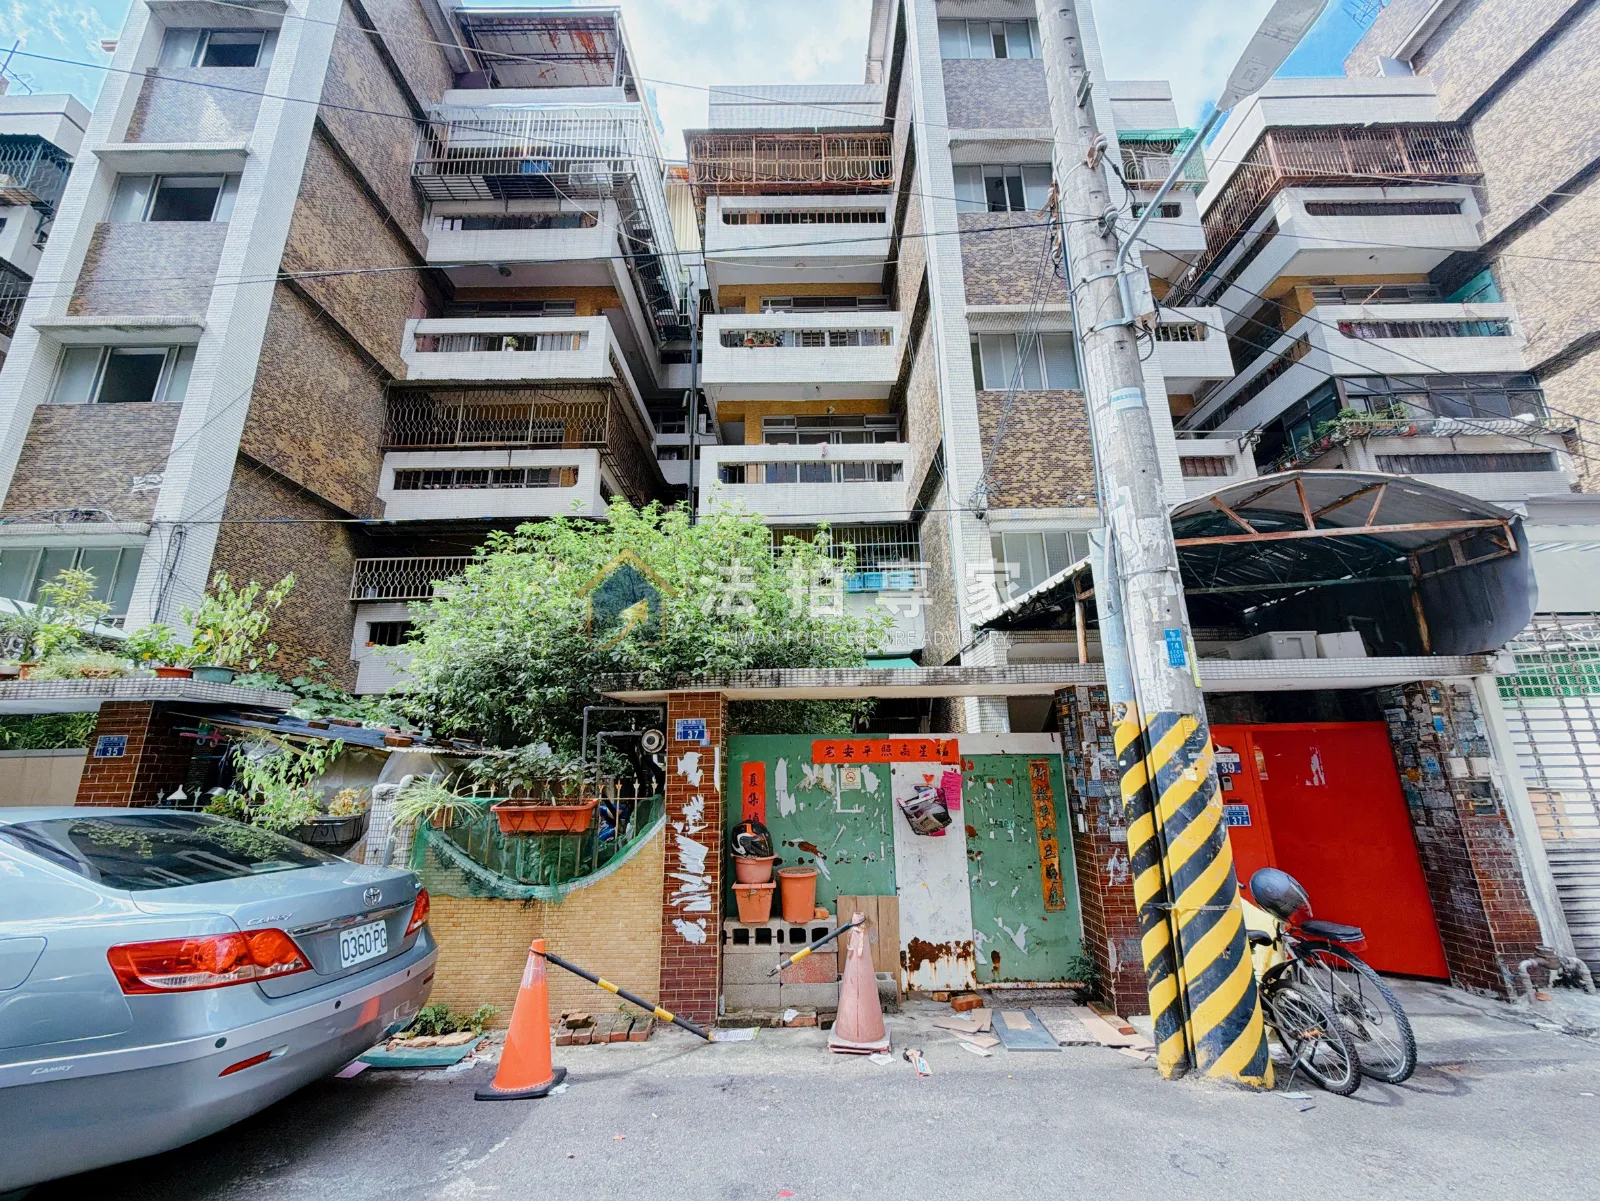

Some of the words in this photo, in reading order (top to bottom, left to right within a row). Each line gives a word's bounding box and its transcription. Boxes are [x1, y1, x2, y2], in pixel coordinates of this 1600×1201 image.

[687, 730, 699, 739] 37
[106, 747, 119, 756] 35
[1221, 762, 1236, 774] 39
